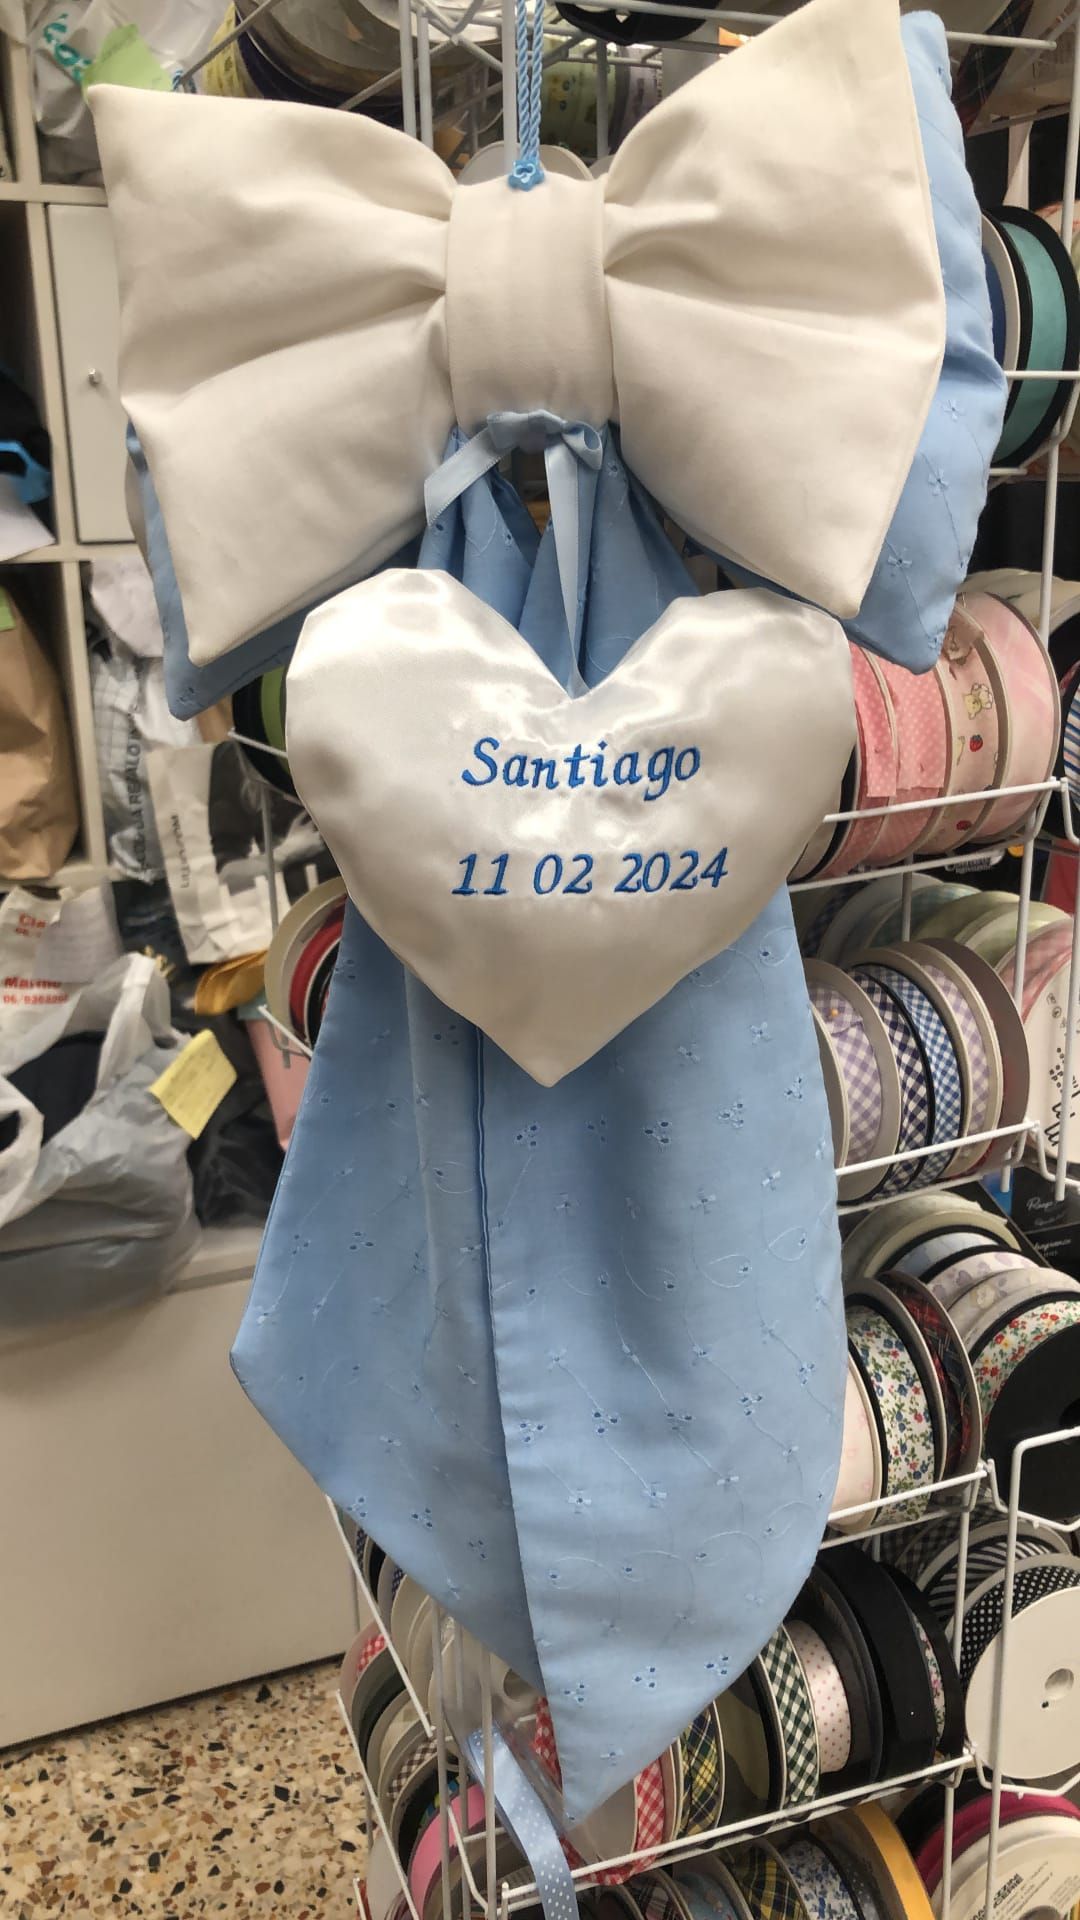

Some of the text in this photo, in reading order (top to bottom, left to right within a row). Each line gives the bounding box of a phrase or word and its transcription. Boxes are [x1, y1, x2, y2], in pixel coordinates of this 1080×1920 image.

[461, 736, 701, 802] Santiago
[451, 847, 729, 896] 11 02 2024
